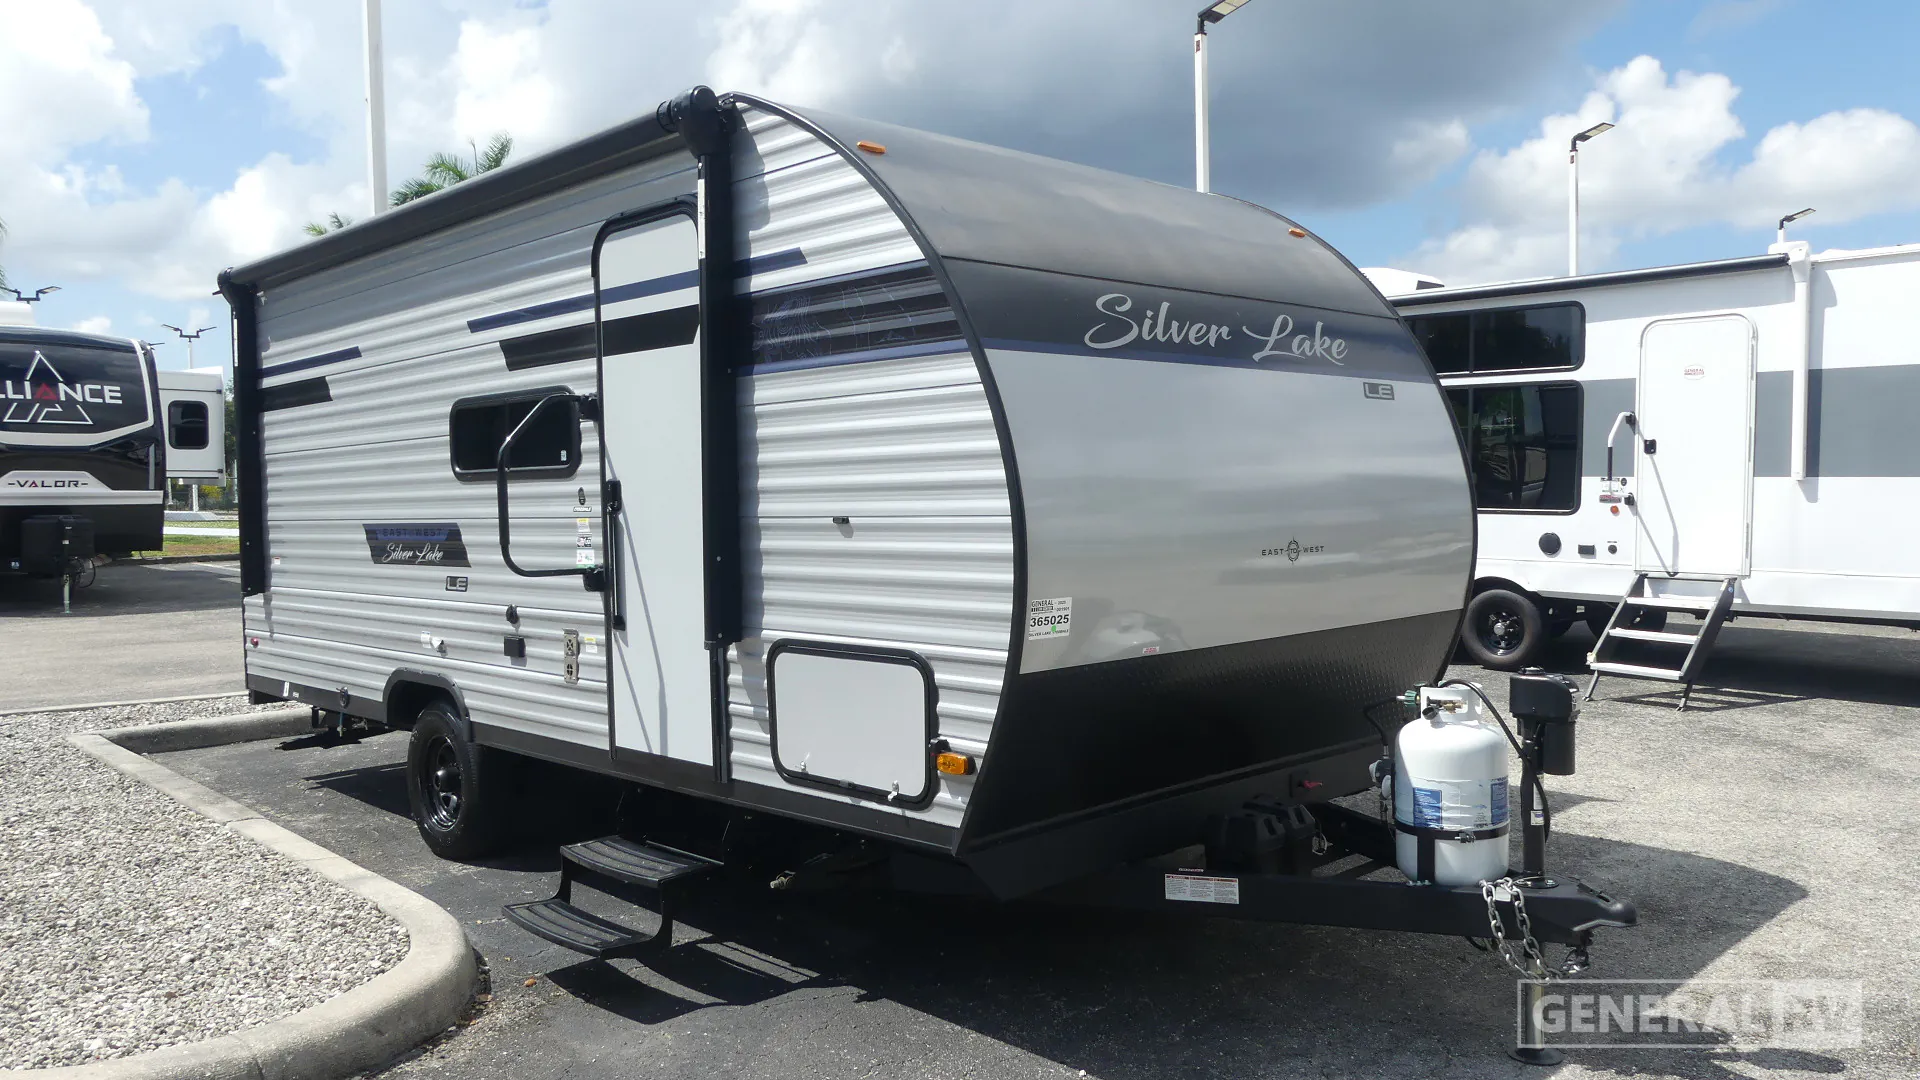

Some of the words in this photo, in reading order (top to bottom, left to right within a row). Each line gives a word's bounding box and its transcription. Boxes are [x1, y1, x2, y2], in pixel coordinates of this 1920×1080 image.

[1084, 293, 1232, 349] Silver
[1242, 314, 1348, 366] Lake
[0, 379, 123, 404] LIANCE
[1364, 383, 1394, 399] LE
[383, 528, 407, 537] EAST
[415, 528, 443, 537] WEST
[382, 542, 414, 563] Silver
[416, 542, 444, 564] Lake
[1262, 548, 1284, 556] EAST
[1303, 545, 1324, 553] WEST
[446, 576, 467, 591] LE
[1030, 614, 1069, 627] 365025
